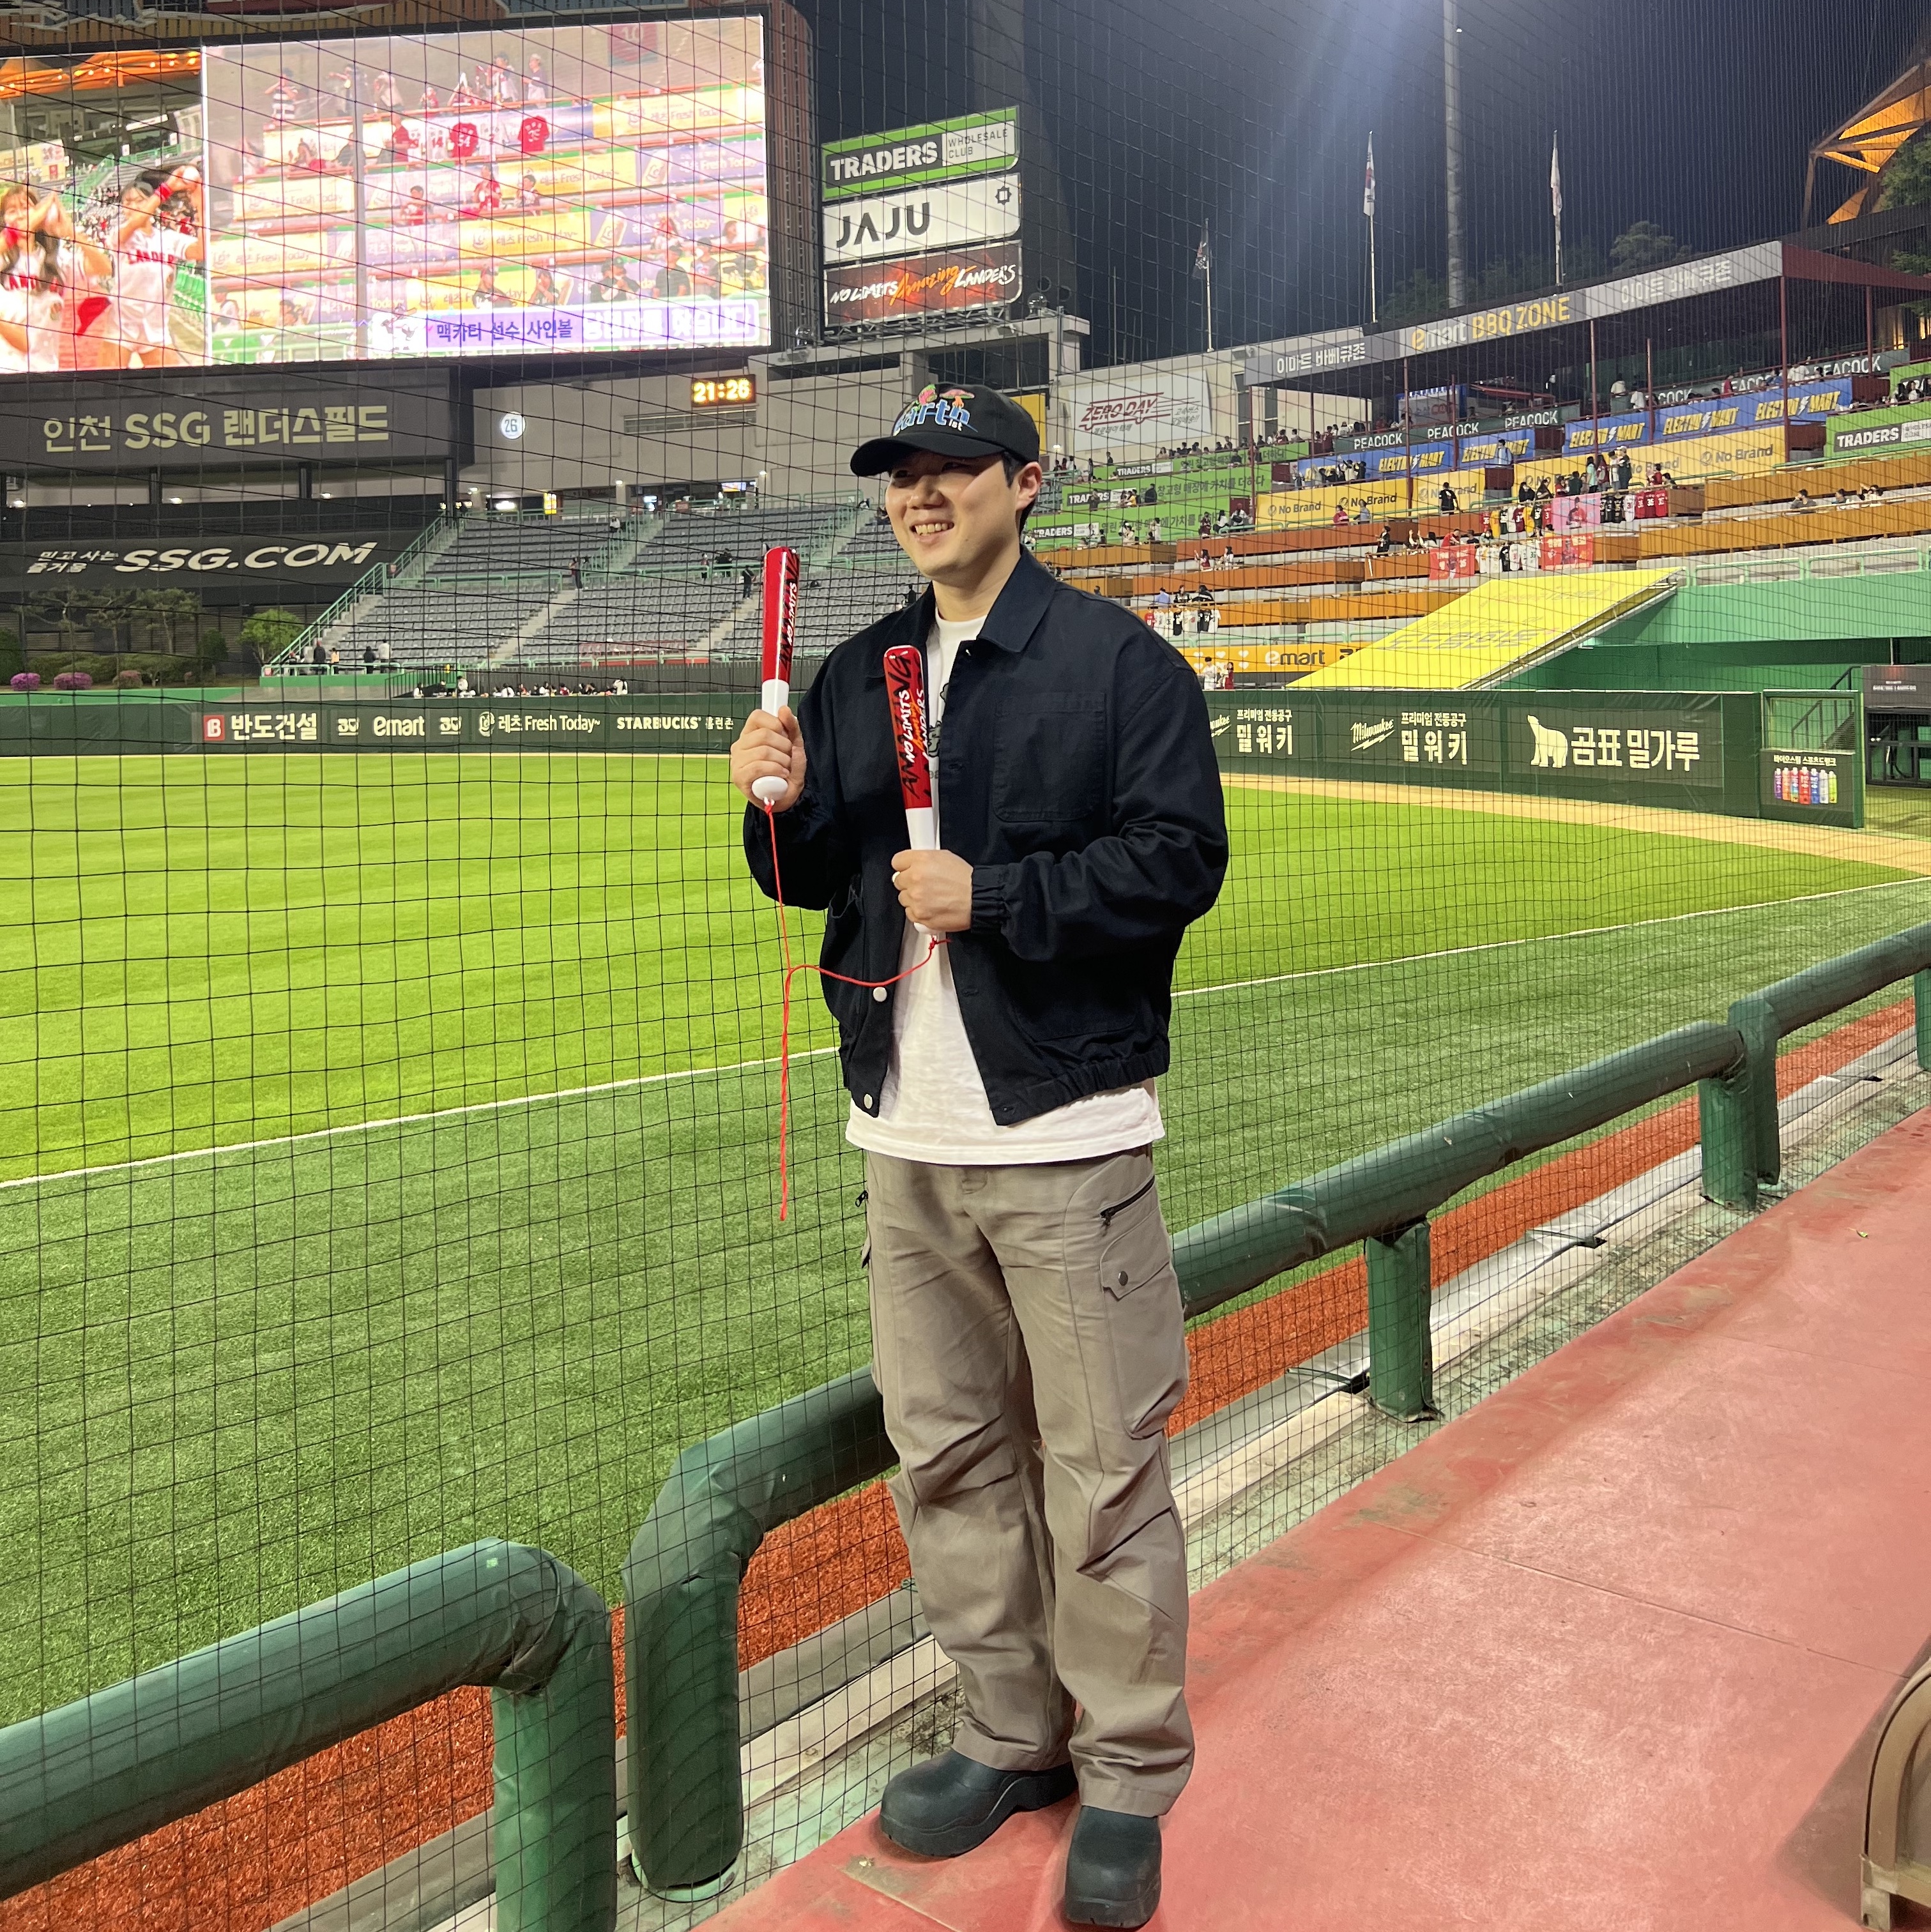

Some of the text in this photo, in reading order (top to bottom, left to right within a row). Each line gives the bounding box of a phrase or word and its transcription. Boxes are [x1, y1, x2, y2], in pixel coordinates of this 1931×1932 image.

[830, 128, 1008, 181] TRADERS WHOLESALE
[948, 147, 973, 158] CLUB
[836, 202, 930, 248] JAJU
[830, 264, 1016, 307] NO LIMITS Amazing LANDERS
[1621, 276, 1664, 304] 이마트
[437, 322, 481, 342] 맥카티
[491, 321, 520, 341] 선수
[527, 319, 573, 339] 사인볼
[1411, 296, 1570, 351] emart BBQ ZONE
[1277, 342, 1365, 374] 이마트 바베큐존
[693, 377, 750, 403] 21:26
[893, 399, 971, 437] earth
[1081, 397, 1158, 422] ZERO DAY
[1504, 410, 1558, 429] PEACOCK
[43, 406, 390, 453] 인천 SSG 랜더스필드
[505, 419, 517, 432] 26
[1428, 422, 1479, 439] PEACOCK
[1354, 432, 1402, 450] PEACOCK
[1836, 426, 1899, 448] TRADERS
[1419, 451, 1446, 468] MART
[1716, 444, 1773, 463] No Brand
[1117, 465, 1151, 476] TRADERS
[1157, 483, 1182, 497] 창고형
[1210, 477, 1236, 491] 가치를
[1279, 501, 1321, 515] No Brand
[1367, 493, 1398, 505] Brand
[1171, 513, 1196, 526] 가치를
[1034, 526, 1073, 538] TRADERS
[80, 550, 119, 561] 사는
[114, 542, 379, 573] SSG.COM
[786, 582, 798, 646] NO LIMITS
[1265, 650, 1325, 666] emart
[373, 715, 425, 736] emart
[498, 714, 523, 733] 레츠
[525, 715, 557, 731] Fresh
[617, 716, 699, 730] STARBUCKS
[1237, 708, 1293, 722] 프리미엄 전동공구
[1401, 711, 1467, 727] 프리미엄 전동공구
[231, 713, 317, 741] 반도건설
[898, 689, 915, 763] NO LIMITS
[1350, 719, 1394, 743] Milwaukee
[1237, 724, 1293, 755] 밀워키
[1401, 729, 1467, 765] 밀워키
[1571, 727, 1700, 772] 곰표 밀가루
